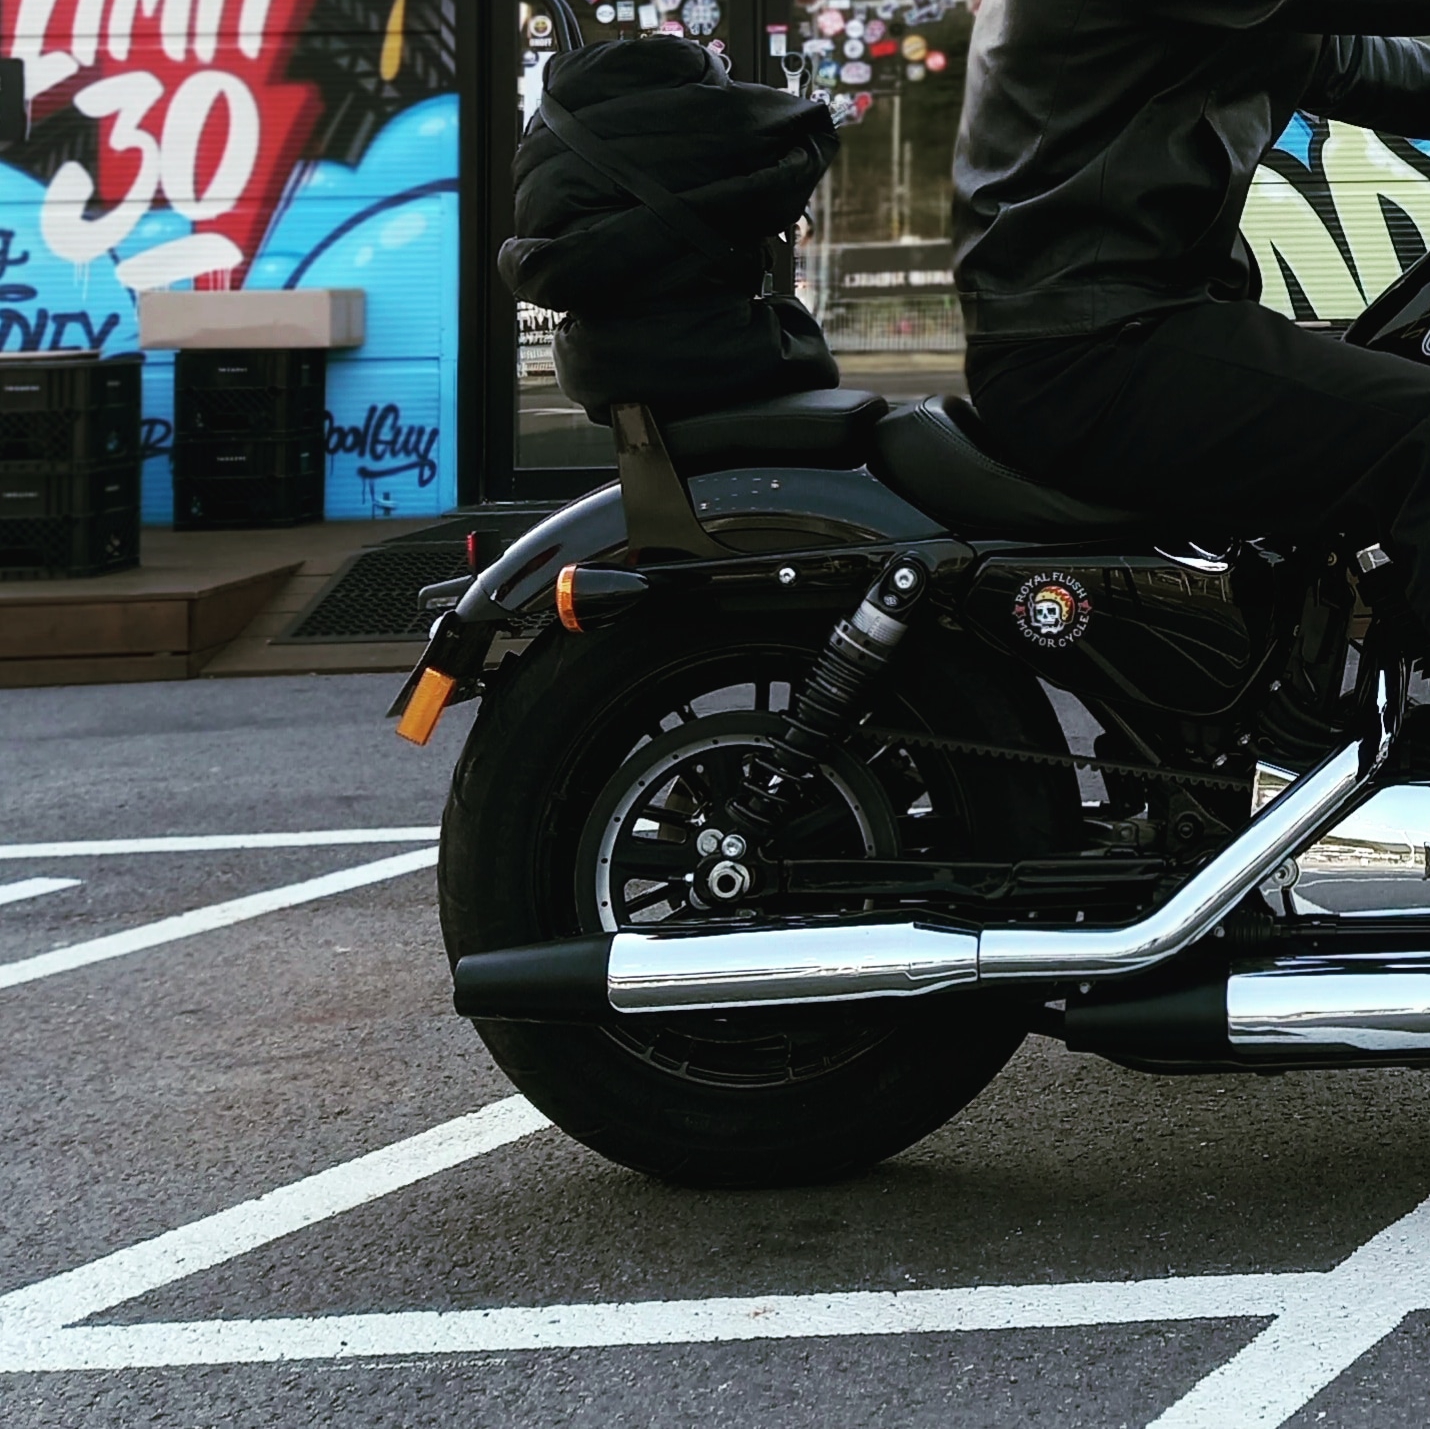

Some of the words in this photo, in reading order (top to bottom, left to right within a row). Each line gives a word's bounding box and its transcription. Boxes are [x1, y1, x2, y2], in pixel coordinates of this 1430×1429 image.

[40, 69, 261, 261] 30
[1014, 572, 1051, 603] ROYAL
[1052, 571, 1088, 599] FLUSH
